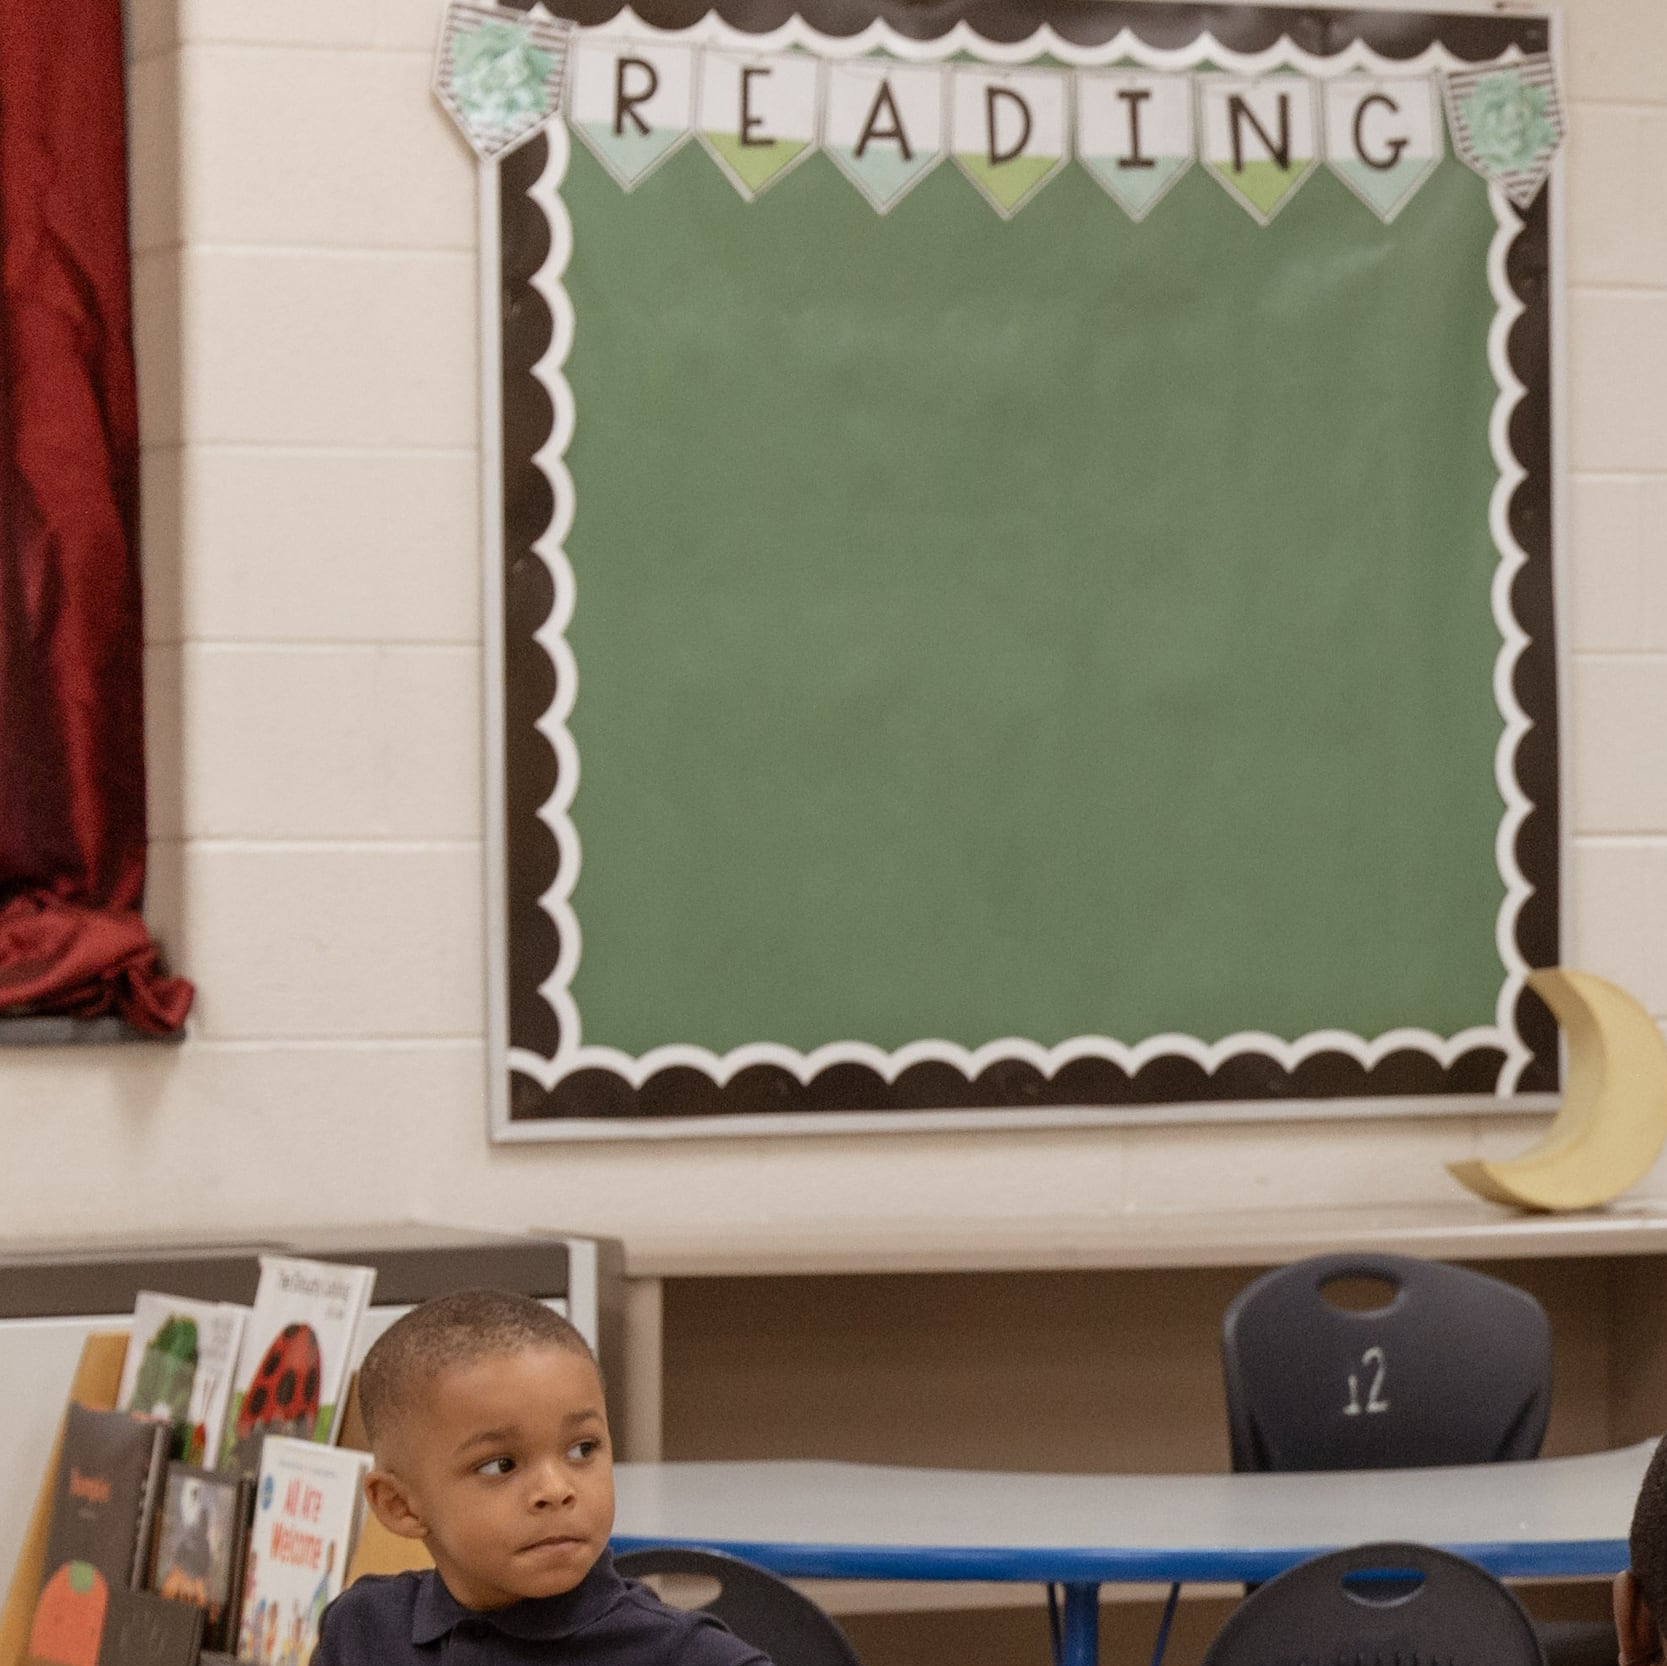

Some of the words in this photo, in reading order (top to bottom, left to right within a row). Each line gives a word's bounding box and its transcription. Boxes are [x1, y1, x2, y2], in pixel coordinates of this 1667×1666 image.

[613, 57, 1409, 173] READING
[1342, 1346, 1391, 1416] 12
[283, 1478, 301, 1517] All
[303, 1485, 324, 1522] Are
[270, 1522, 323, 1573] Welcome
